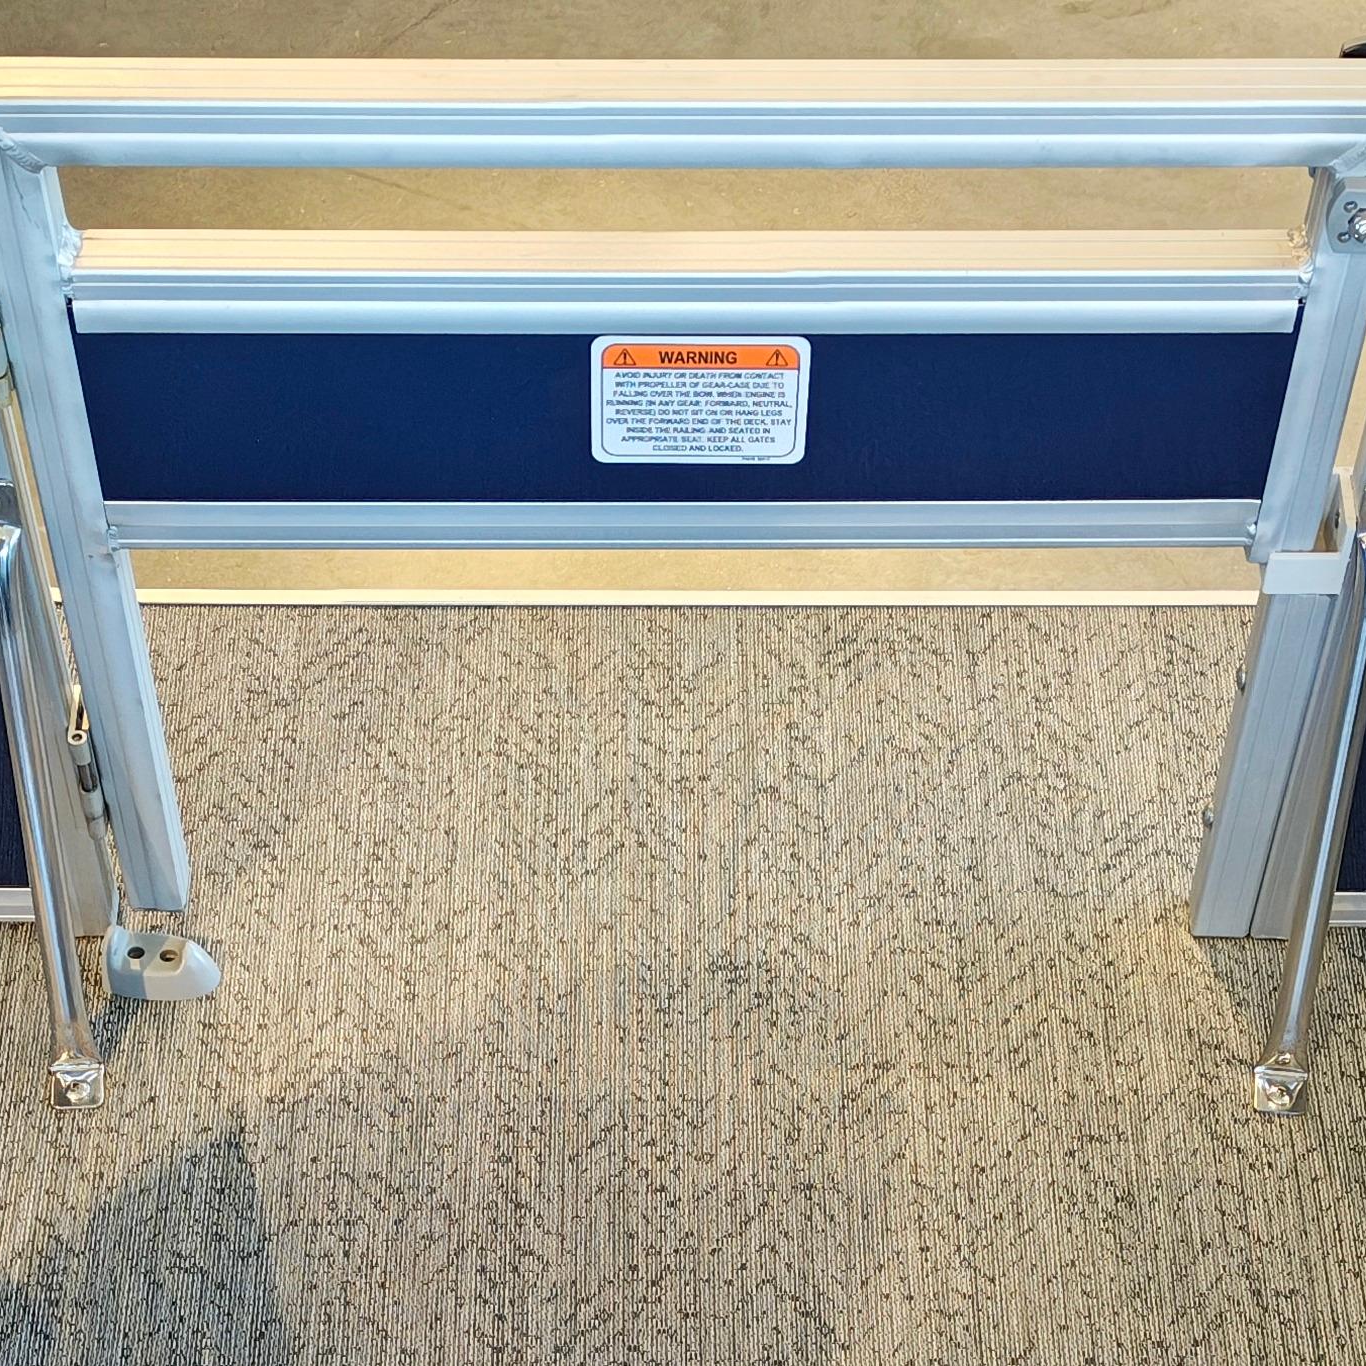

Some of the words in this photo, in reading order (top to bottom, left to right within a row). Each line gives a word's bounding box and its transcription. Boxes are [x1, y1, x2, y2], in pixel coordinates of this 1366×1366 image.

[659, 351, 738, 364] WARNING
[638, 381, 687, 389] PROPELLER
[752, 400, 793, 408] NEUTRAL,
[770, 418, 792, 426] STAY
